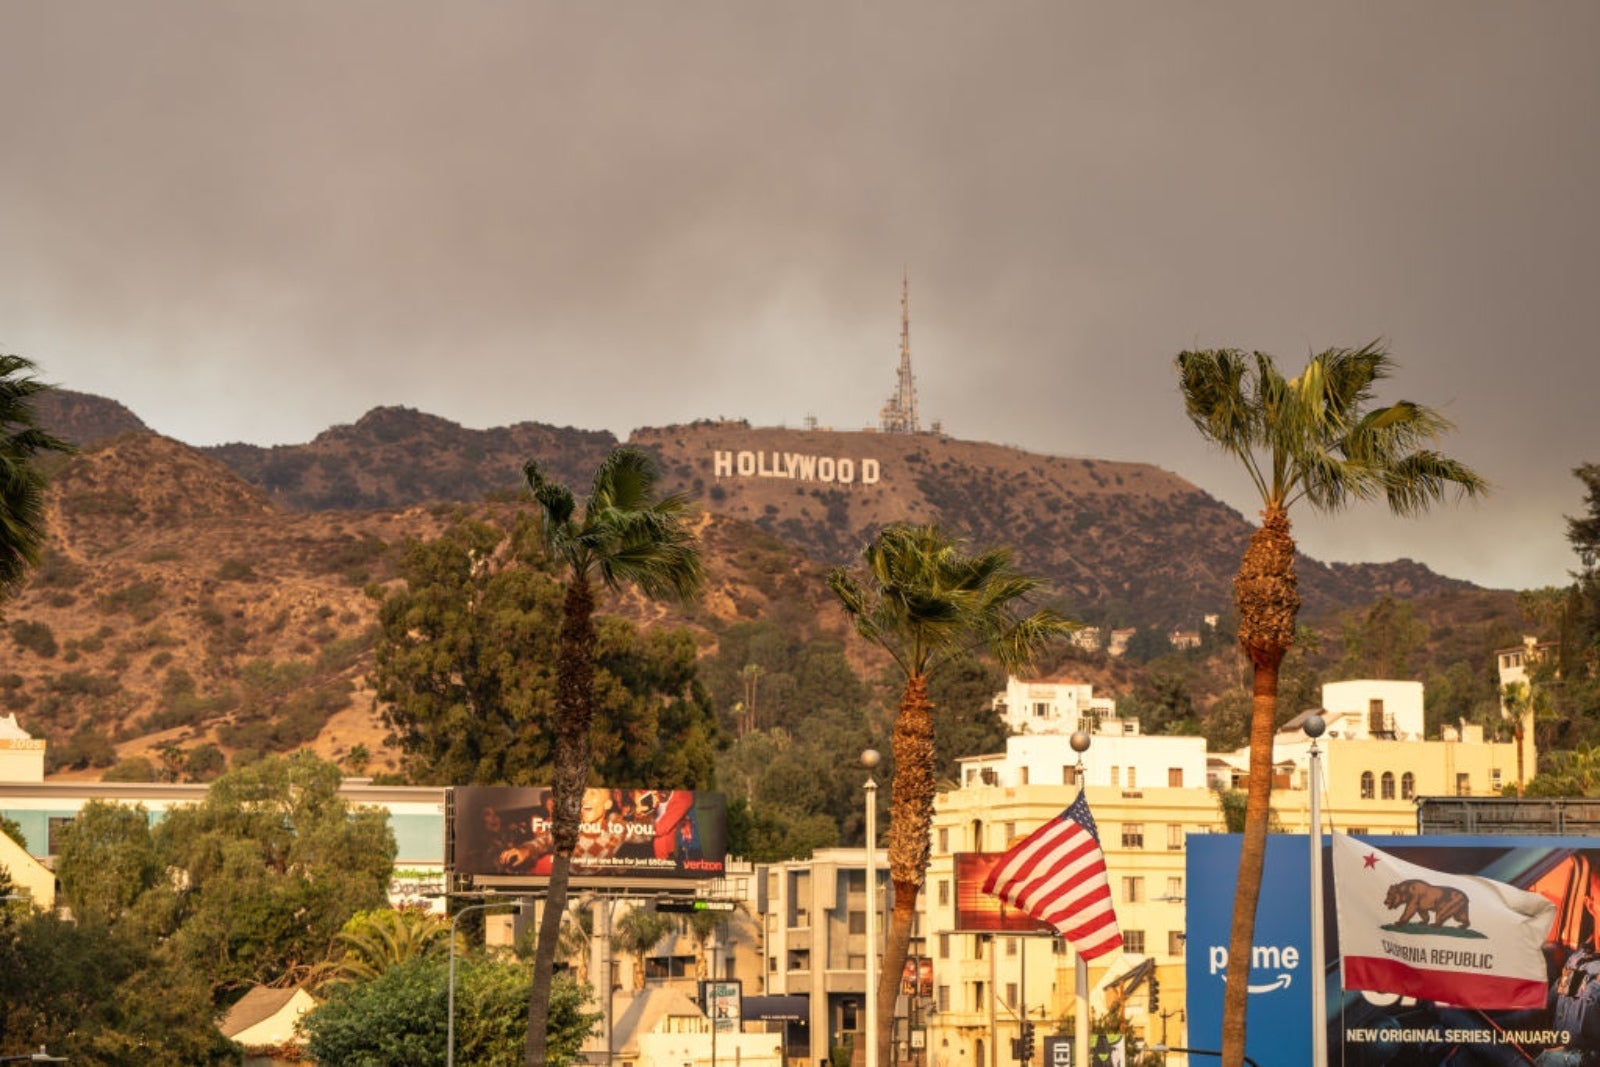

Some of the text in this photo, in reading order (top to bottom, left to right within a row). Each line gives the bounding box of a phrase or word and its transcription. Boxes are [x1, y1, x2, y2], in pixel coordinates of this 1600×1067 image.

[714, 451, 880, 484] HOLLYWOOD
[579, 821, 605, 835] ou,
[608, 821, 624, 834] to
[625, 823, 657, 838] you.
[683, 859, 723, 871] verizon
[1209, 945, 1299, 975] pme
[1430, 948, 1493, 970] REPUBLIC
[1346, 1028, 1570, 1044] NEW ORIGINAL SERIES JANUARY 9
